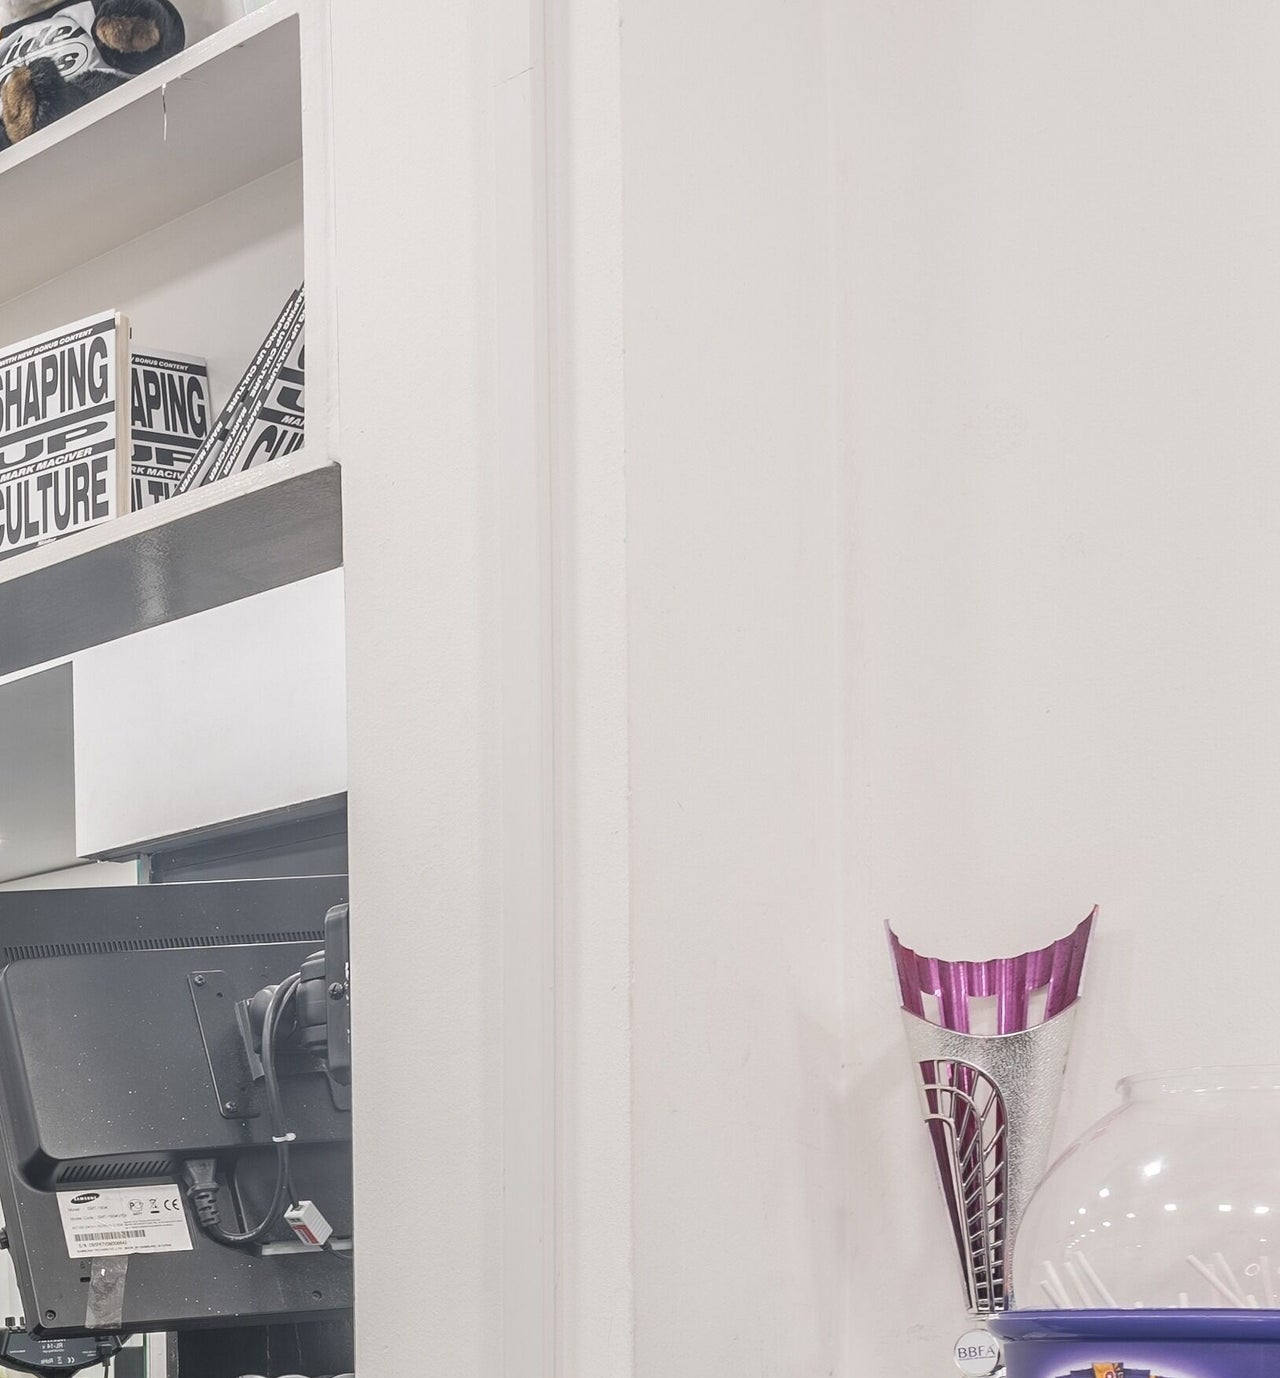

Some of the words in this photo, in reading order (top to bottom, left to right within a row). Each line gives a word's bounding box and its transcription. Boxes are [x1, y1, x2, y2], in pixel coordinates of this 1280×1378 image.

[0, 353, 17, 367] WITH
[17, 348, 34, 362] NEW
[34, 338, 58, 355] BONUS
[59, 328, 93, 347] CONTENT
[134, 356, 158, 366] BONUS
[158, 360, 189, 372] CONTENT
[264, 340, 292, 392] CULTURE
[226, 366, 258, 414] CULTURE
[249, 348, 278, 398] CULTURE
[132, 368, 207, 438] APING
[0, 462, 35, 482] MARK
[34, 447, 93, 470] MACIVER
[146, 466, 185, 480] MACIV
[958, 1346, 996, 1359] BBFA
